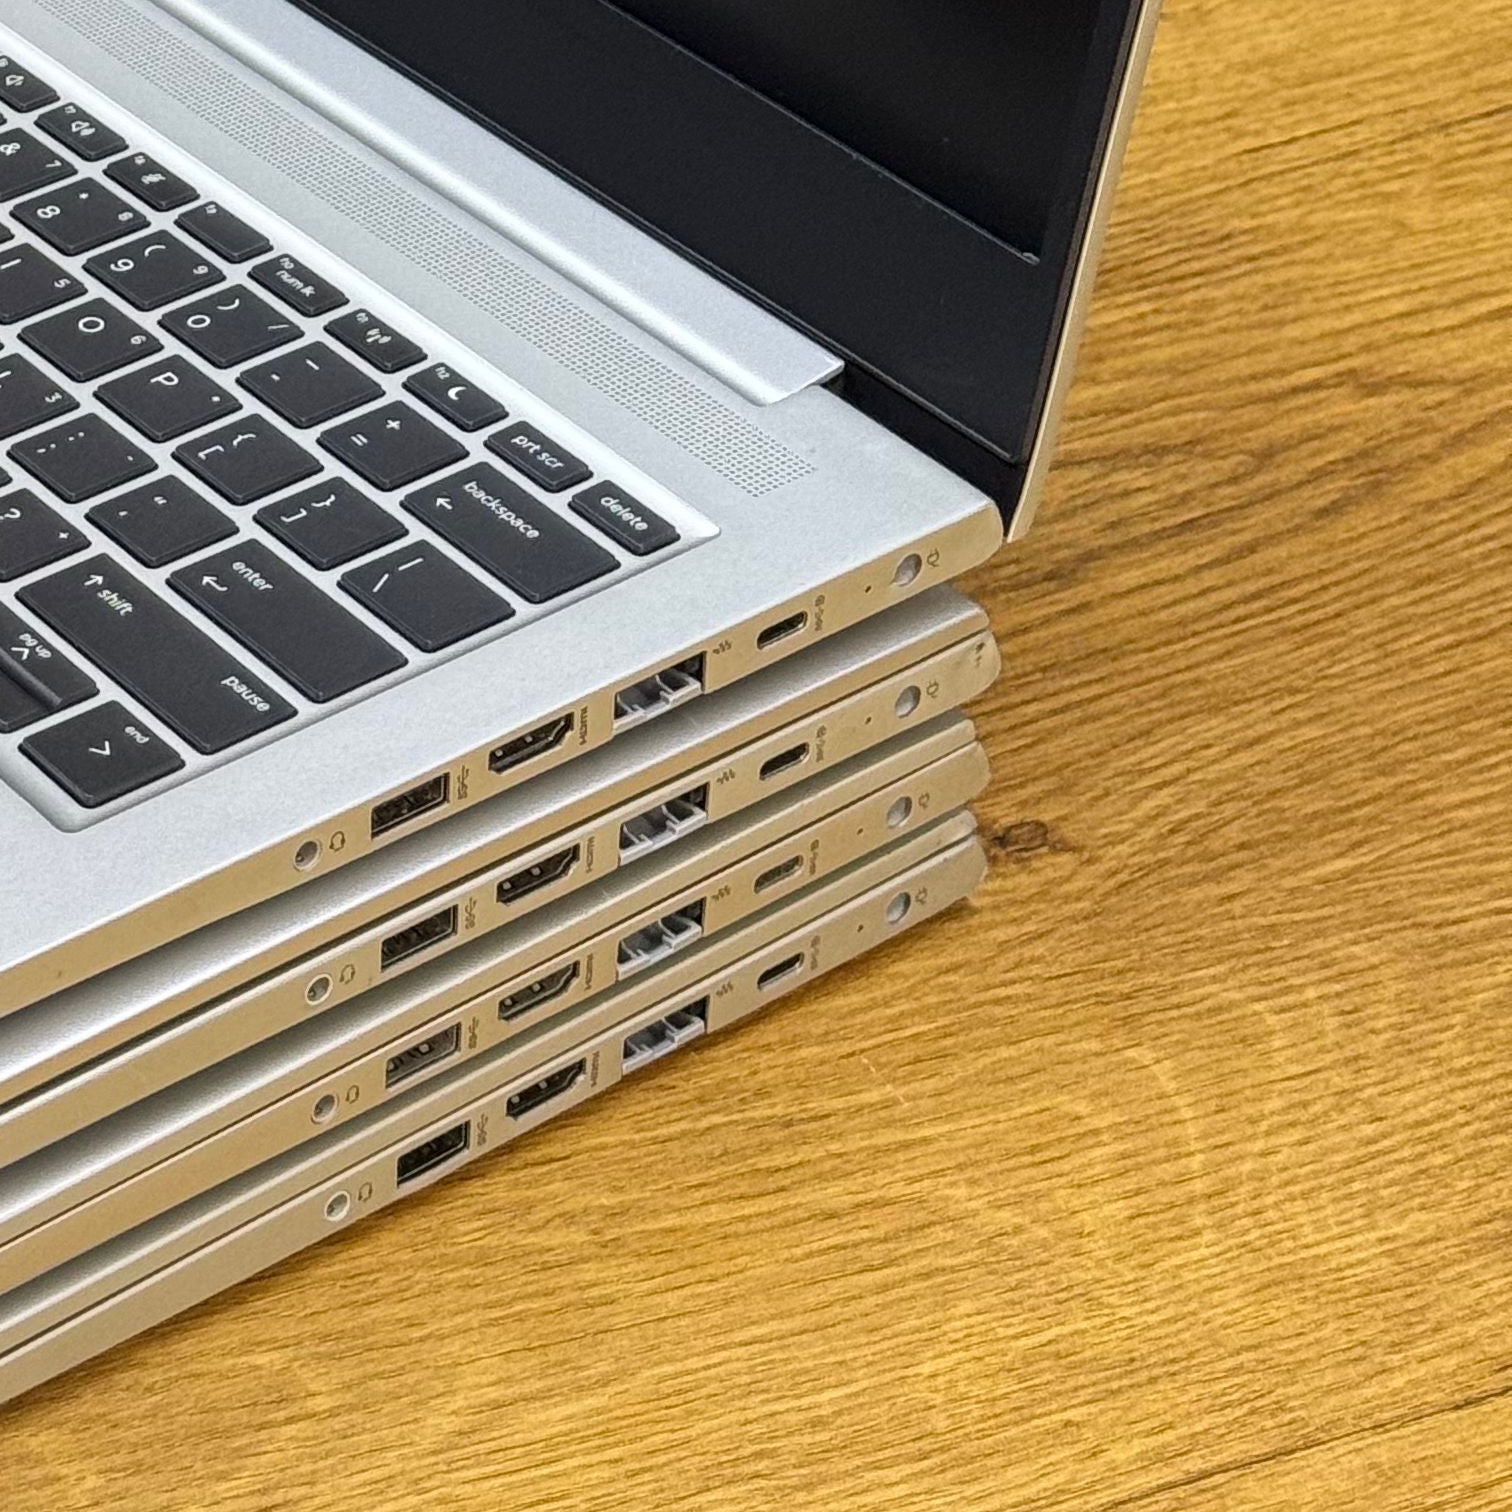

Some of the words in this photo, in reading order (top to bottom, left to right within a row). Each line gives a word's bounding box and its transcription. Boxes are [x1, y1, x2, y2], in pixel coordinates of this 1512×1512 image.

[36, 205, 61, 219] 8
[143, 244, 167, 258] (
[109, 258, 135, 272] 9
[77, 316, 105, 334] O
[149, 371, 179, 386] P
[510, 435, 541, 454] prt
[536, 452, 564, 469] scr
[462, 480, 540, 539] backspace
[600, 496, 649, 531] delete
[232, 561, 274, 591] enter
[96, 589, 134, 617] shift
[220, 675, 271, 712] pause
[124, 726, 150, 744] end
